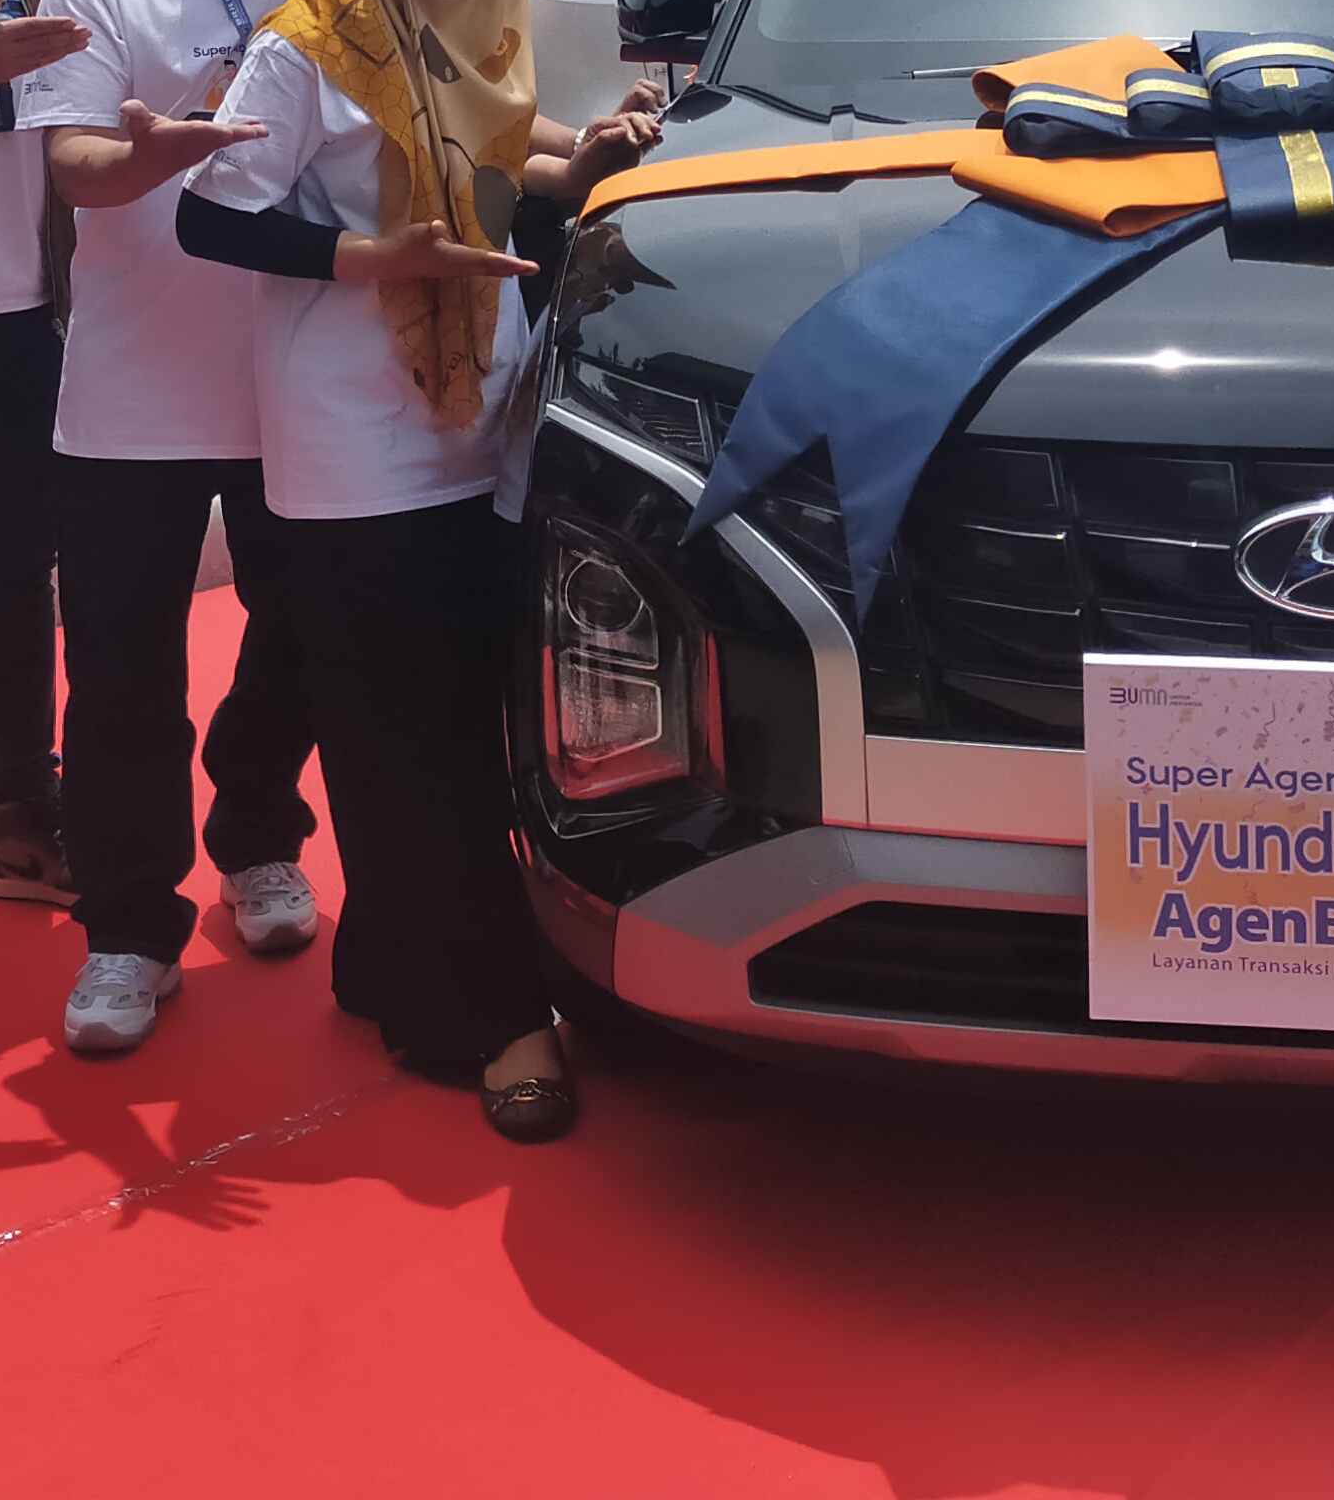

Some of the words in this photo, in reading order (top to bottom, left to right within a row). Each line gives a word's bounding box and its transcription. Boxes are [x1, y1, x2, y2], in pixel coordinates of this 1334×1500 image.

[193, 46, 231, 58] Super
[1110, 687, 1167, 705] BUMN
[1126, 756, 1233, 793] Super
[1152, 952, 1233, 973] Layanan
[1238, 956, 1330, 976] Transaksi
